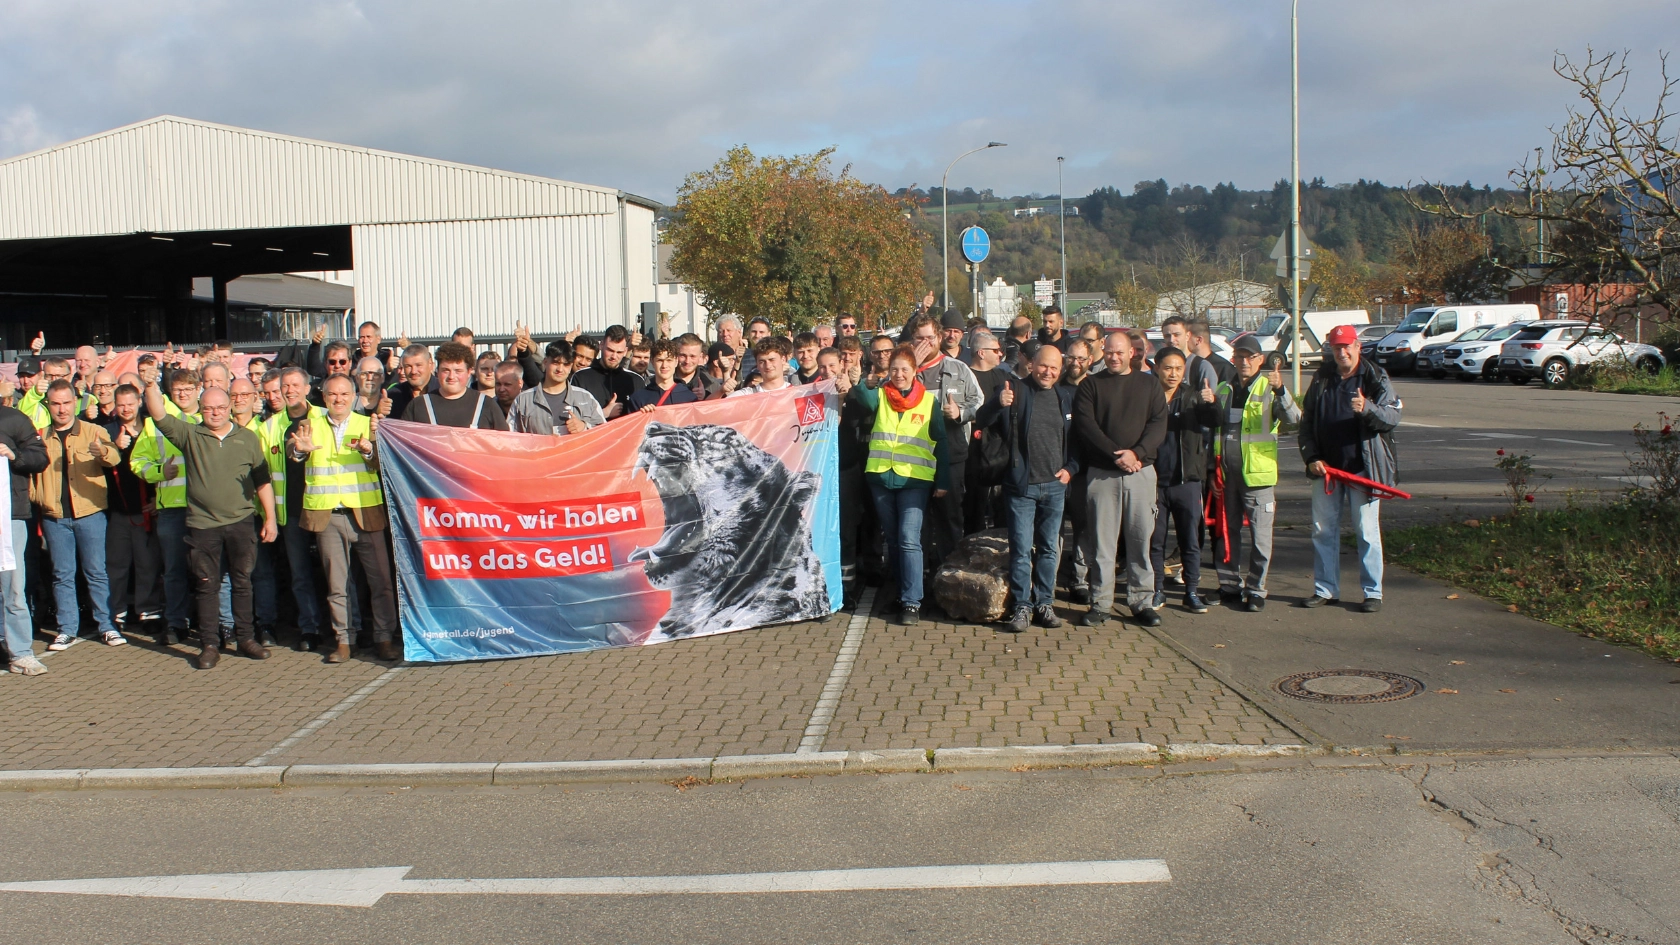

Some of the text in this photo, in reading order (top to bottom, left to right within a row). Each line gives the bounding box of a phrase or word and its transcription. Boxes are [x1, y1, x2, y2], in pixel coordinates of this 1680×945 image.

[423, 504, 637, 532] Komm, wir holen
[429, 544, 606, 571] uns das Geld!
[422, 625, 515, 641] igmetall.de/jugend
